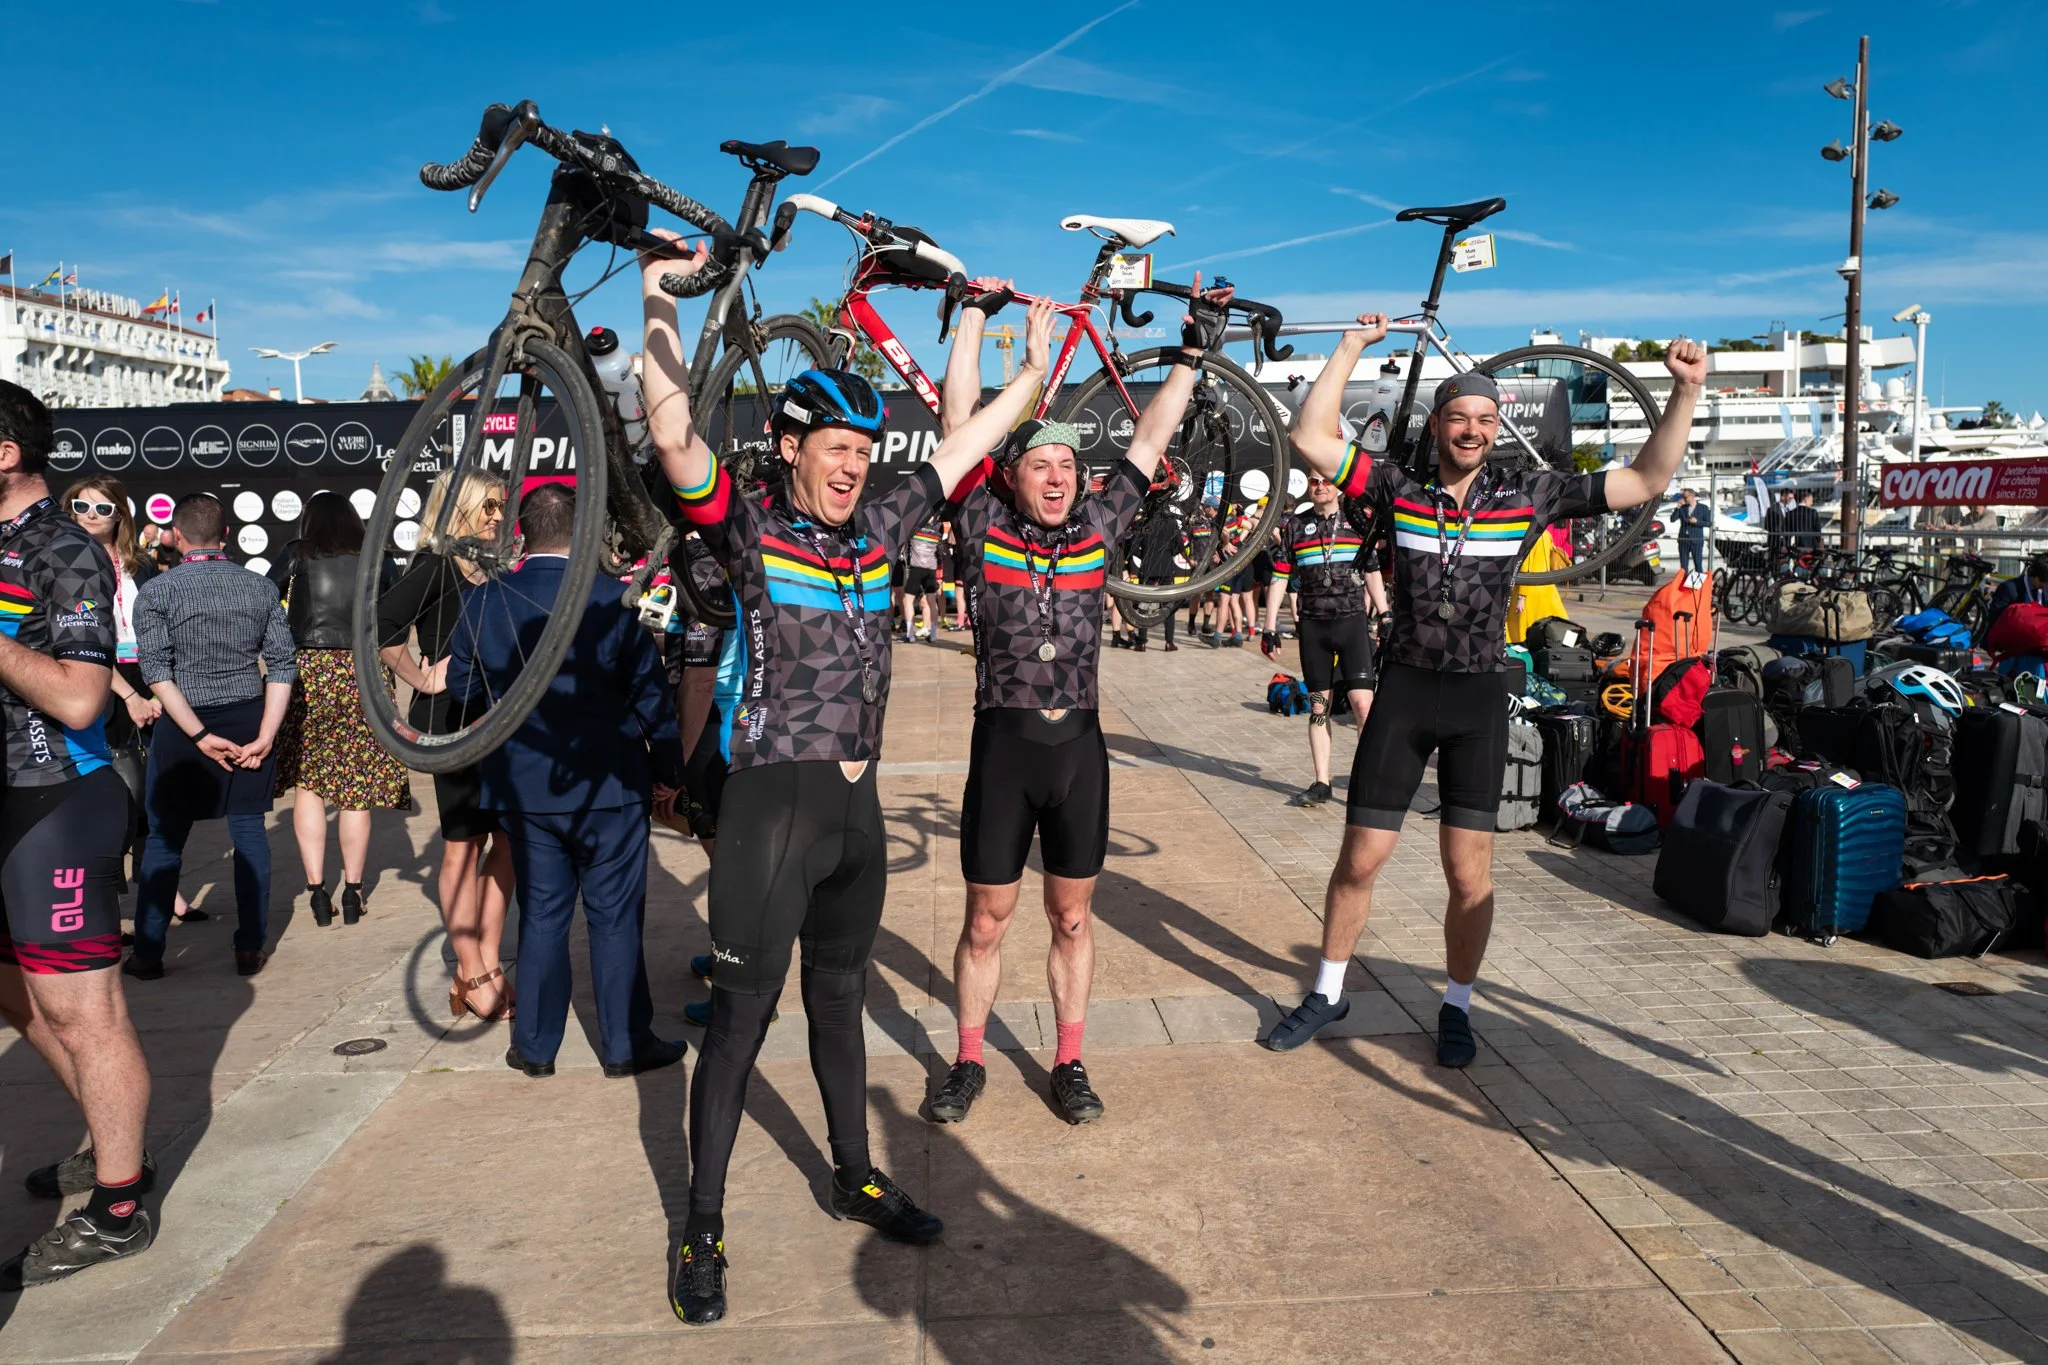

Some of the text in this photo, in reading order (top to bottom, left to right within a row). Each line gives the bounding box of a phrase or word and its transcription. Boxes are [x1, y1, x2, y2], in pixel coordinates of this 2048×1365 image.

[881, 338, 940, 415] Bian
[1043, 345, 1076, 405] Bianchi
[483, 416, 516, 431] CYCLE
[1079, 422, 1096, 430] Knight
[339, 435, 365, 443] WEBB
[455, 417, 463, 447] ASSETS
[1110, 429, 1134, 437] LOCKT
[96, 442, 132, 455] make
[239, 440, 278, 449] SIGNIUM
[337, 442, 366, 451] YATES
[420, 444, 433, 458] &
[869, 430, 943, 463] IPIM
[480, 436, 576, 471] MPI
[2004, 467, 2027, 476] better
[1883, 466, 1994, 501] coram
[2000, 474, 2041, 486] for children
[1995, 488, 2038, 499] since 1739
[970, 585, 978, 626] ASSETS
[56, 612, 92, 622] Legal &
[59, 620, 98, 628] General
[79, 650, 106, 660] ASSETS
[750, 608, 765, 698] REAL ASSETS
[745, 718, 757, 743] Legal
[753, 707, 768, 741] General
[28, 719, 51, 764] ASSETS
